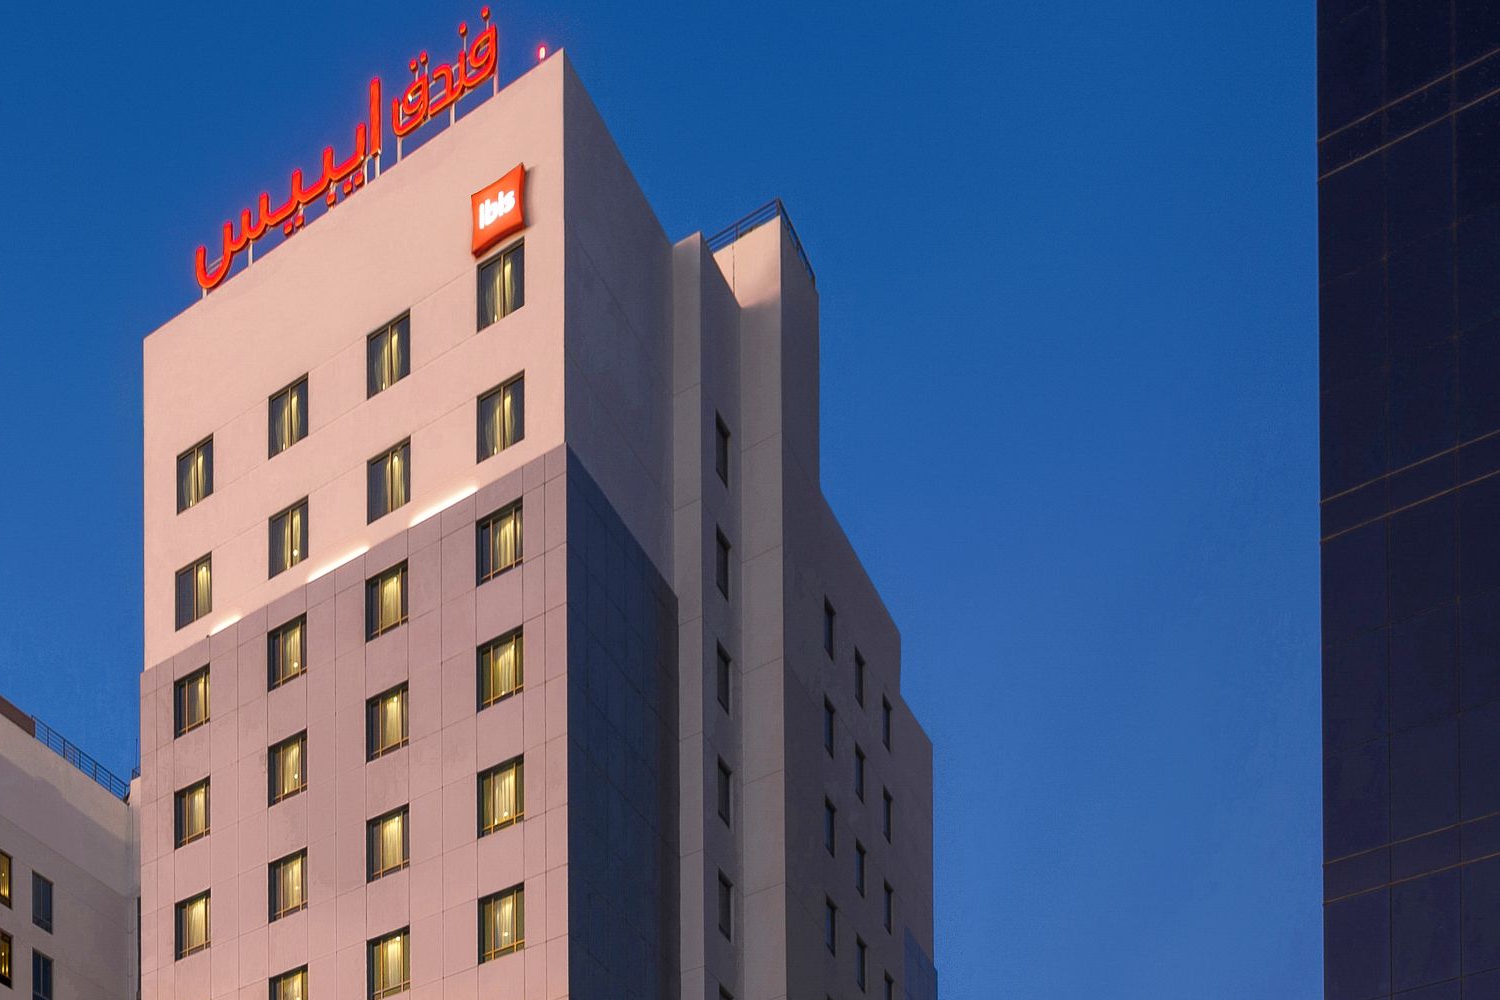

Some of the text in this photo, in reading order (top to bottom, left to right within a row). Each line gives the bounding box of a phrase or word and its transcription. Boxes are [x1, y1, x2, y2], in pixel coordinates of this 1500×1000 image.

[195, 6, 498, 290] فندق ايبيس
[478, 190, 516, 230] ibis
